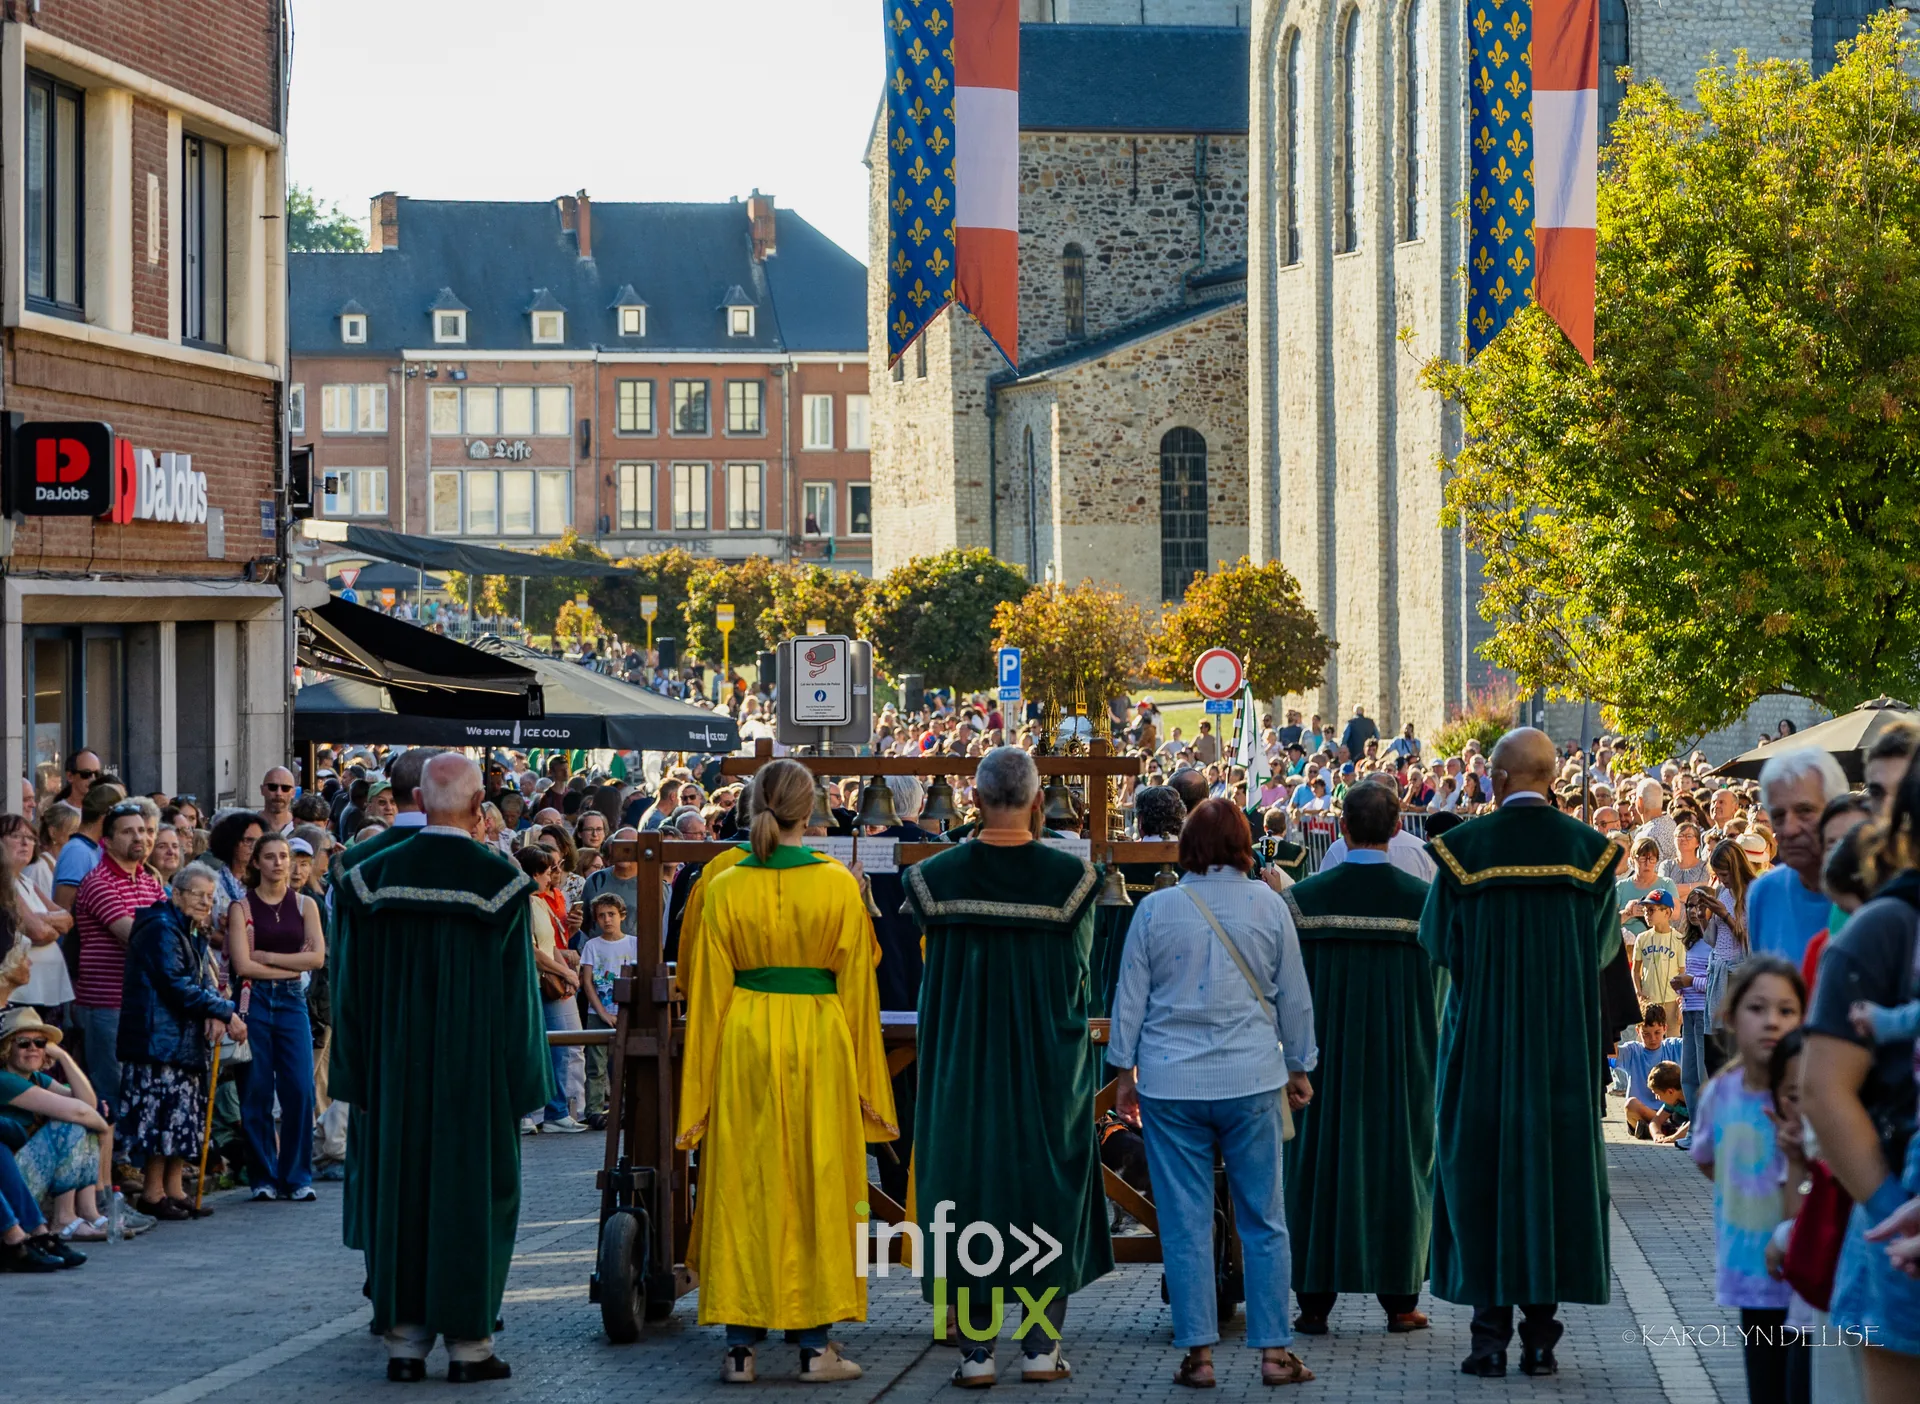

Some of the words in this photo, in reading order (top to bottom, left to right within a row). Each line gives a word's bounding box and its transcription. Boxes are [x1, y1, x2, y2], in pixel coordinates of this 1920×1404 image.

[494, 439, 532, 460] Leffe
[35, 486, 90, 501] DaJobs
[136, 448, 208, 524] DaJobs
[1003, 654, 1018, 682] P
[466, 727, 482, 735] We
[484, 728, 511, 736] serve
[523, 728, 540, 737] ICE
[542, 729, 570, 738] COLD
